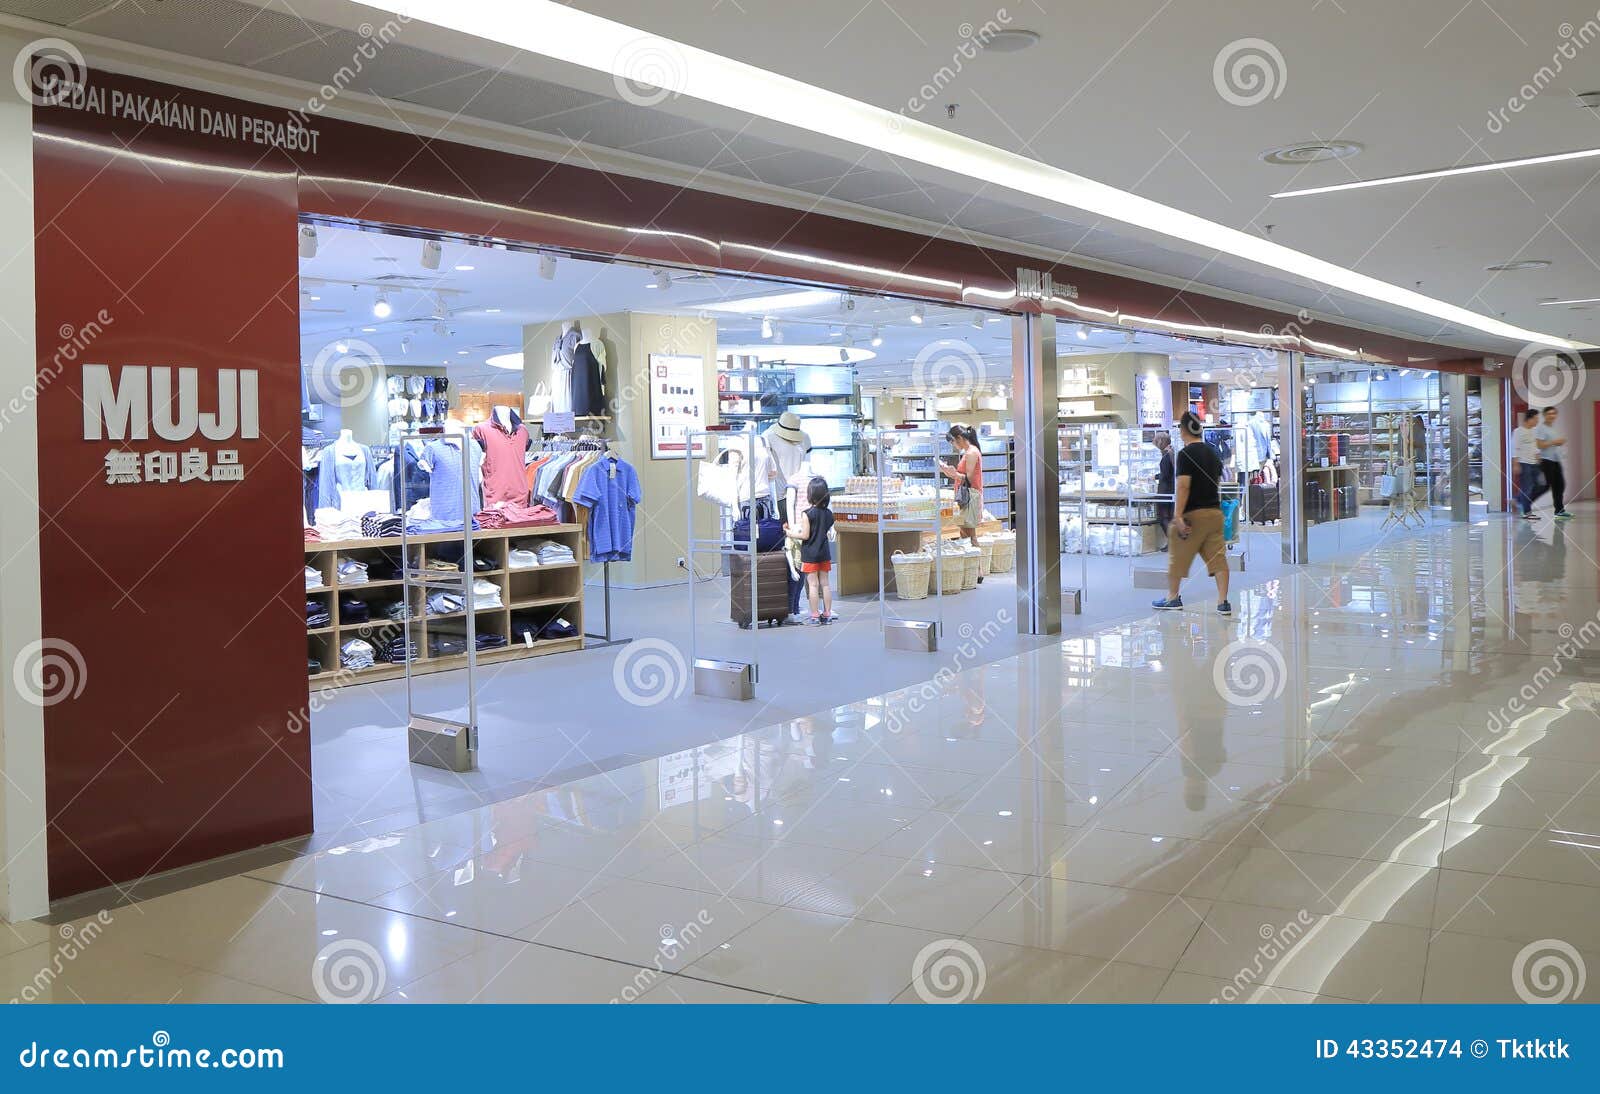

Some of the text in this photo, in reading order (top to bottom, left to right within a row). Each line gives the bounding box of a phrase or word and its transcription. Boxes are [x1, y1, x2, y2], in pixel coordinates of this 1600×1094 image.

[42, 76, 320, 154] KEDAI PAKAIAN DAN PERABOT
[82, 364, 259, 441] MUJI
[104, 448, 244, 485] 無印良品
